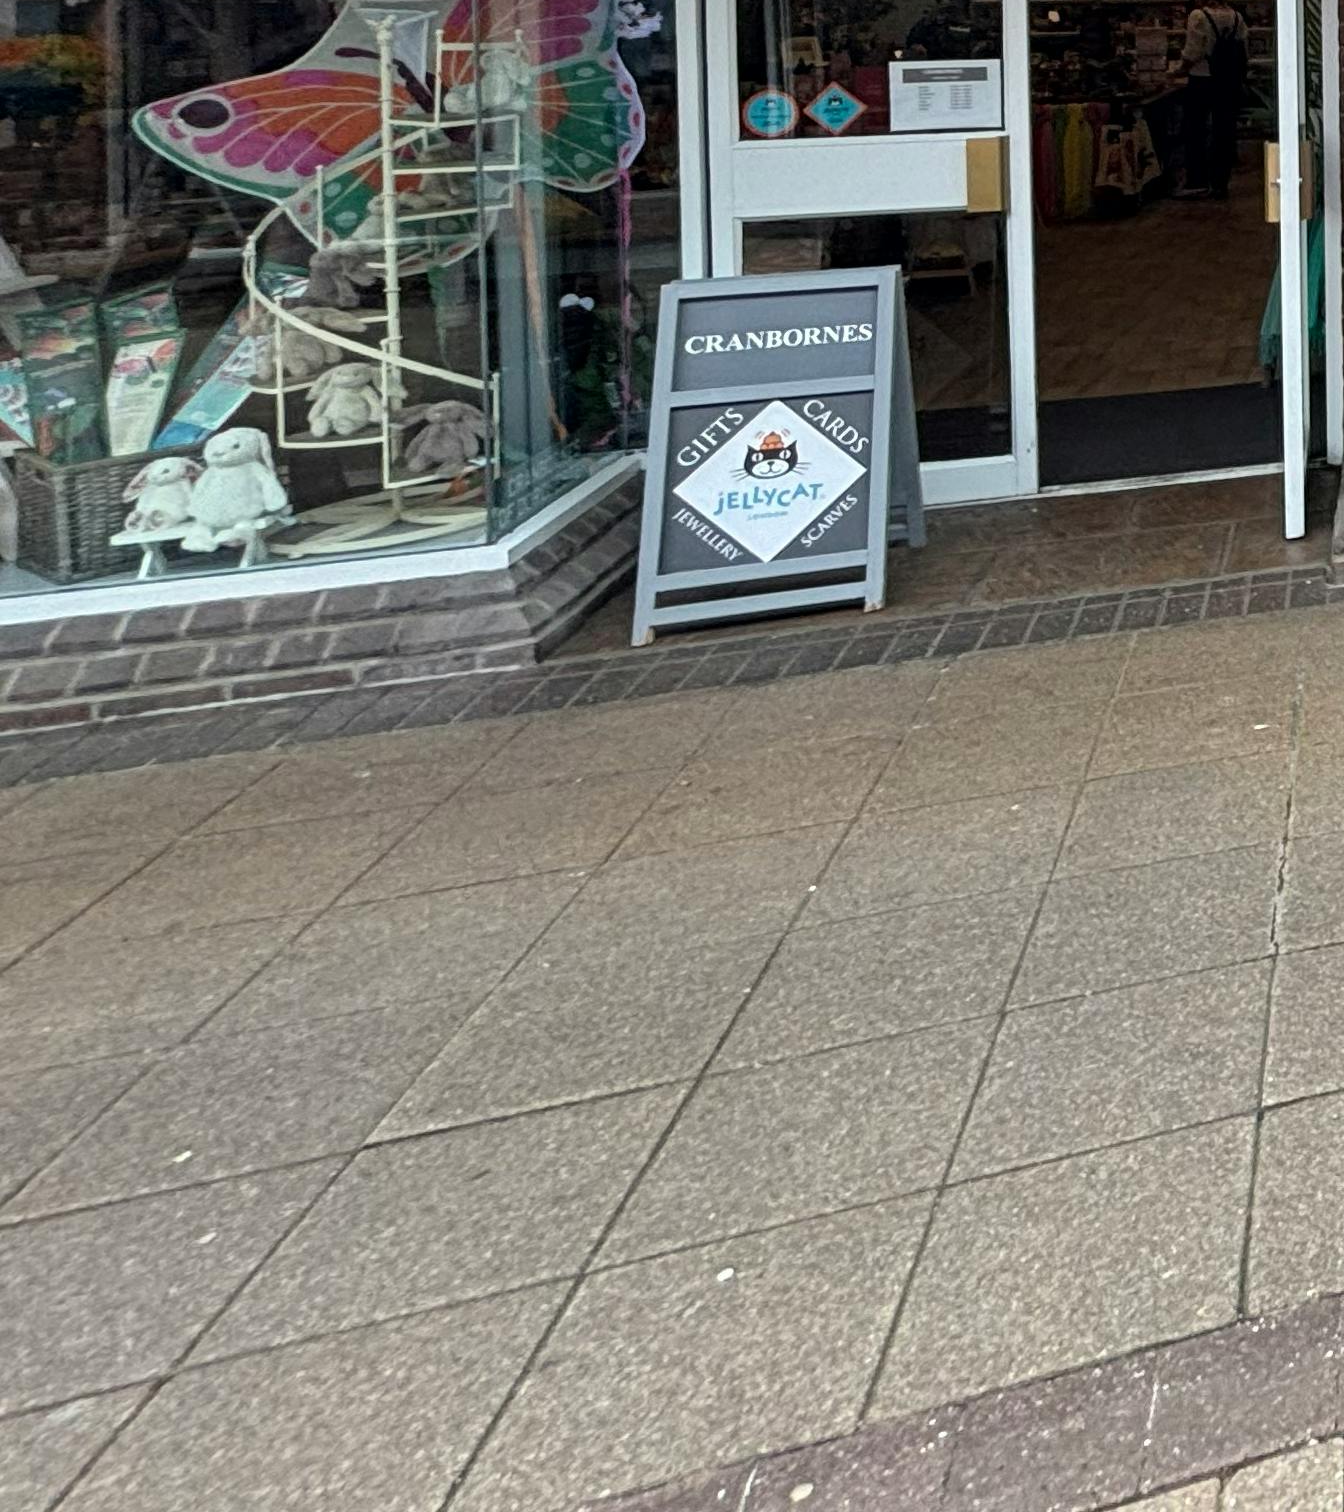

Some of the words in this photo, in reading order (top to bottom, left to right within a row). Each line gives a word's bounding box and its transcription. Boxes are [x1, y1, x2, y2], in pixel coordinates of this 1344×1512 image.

[684, 323, 873, 355] CRANBORNES
[677, 407, 745, 467] GIFTS
[803, 399, 870, 455] CARDS
[672, 507, 745, 562] JEWELLERY
[800, 493, 859, 548] SCARVES
